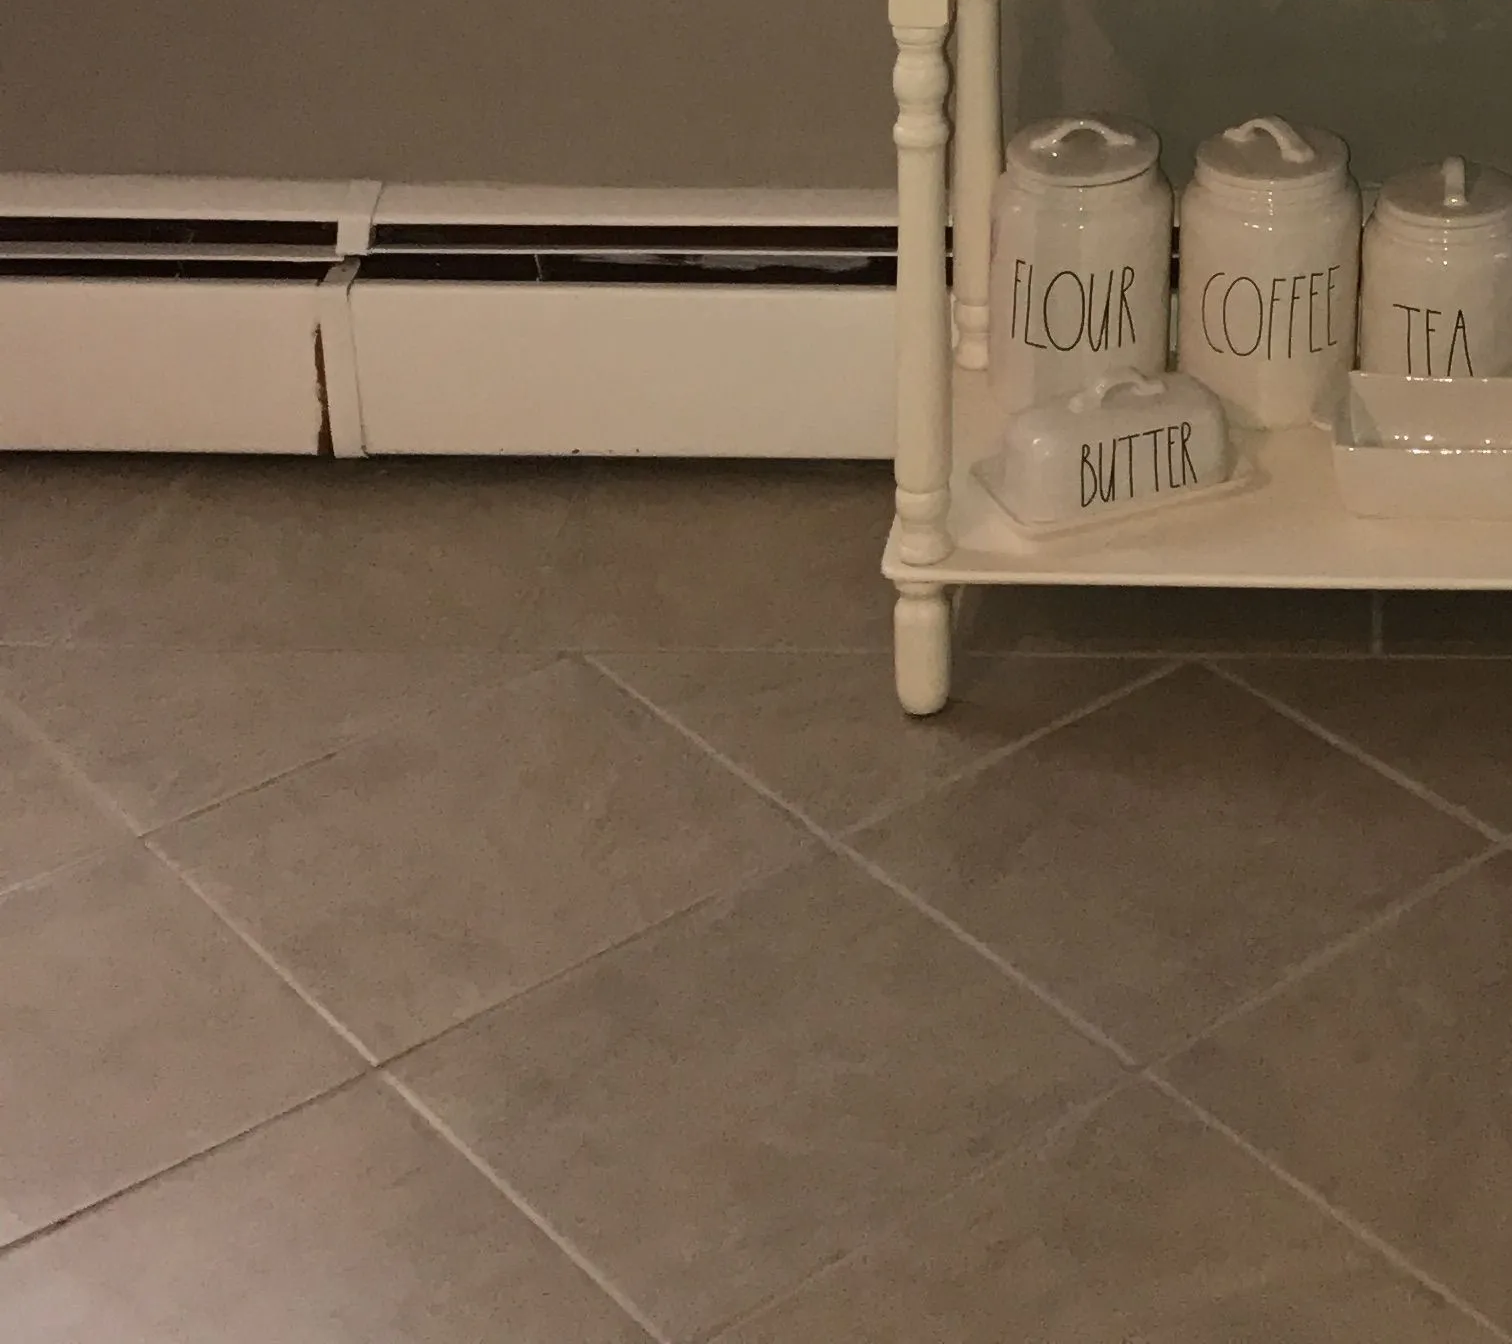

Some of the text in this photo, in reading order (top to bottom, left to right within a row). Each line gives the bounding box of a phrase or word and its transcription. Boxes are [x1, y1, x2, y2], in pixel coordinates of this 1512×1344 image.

[1012, 259, 1136, 352] FLOUR
[1202, 265, 1341, 360] COFFEE
[1393, 303, 1474, 378] TEA
[1081, 421, 1198, 508] BUTTER
